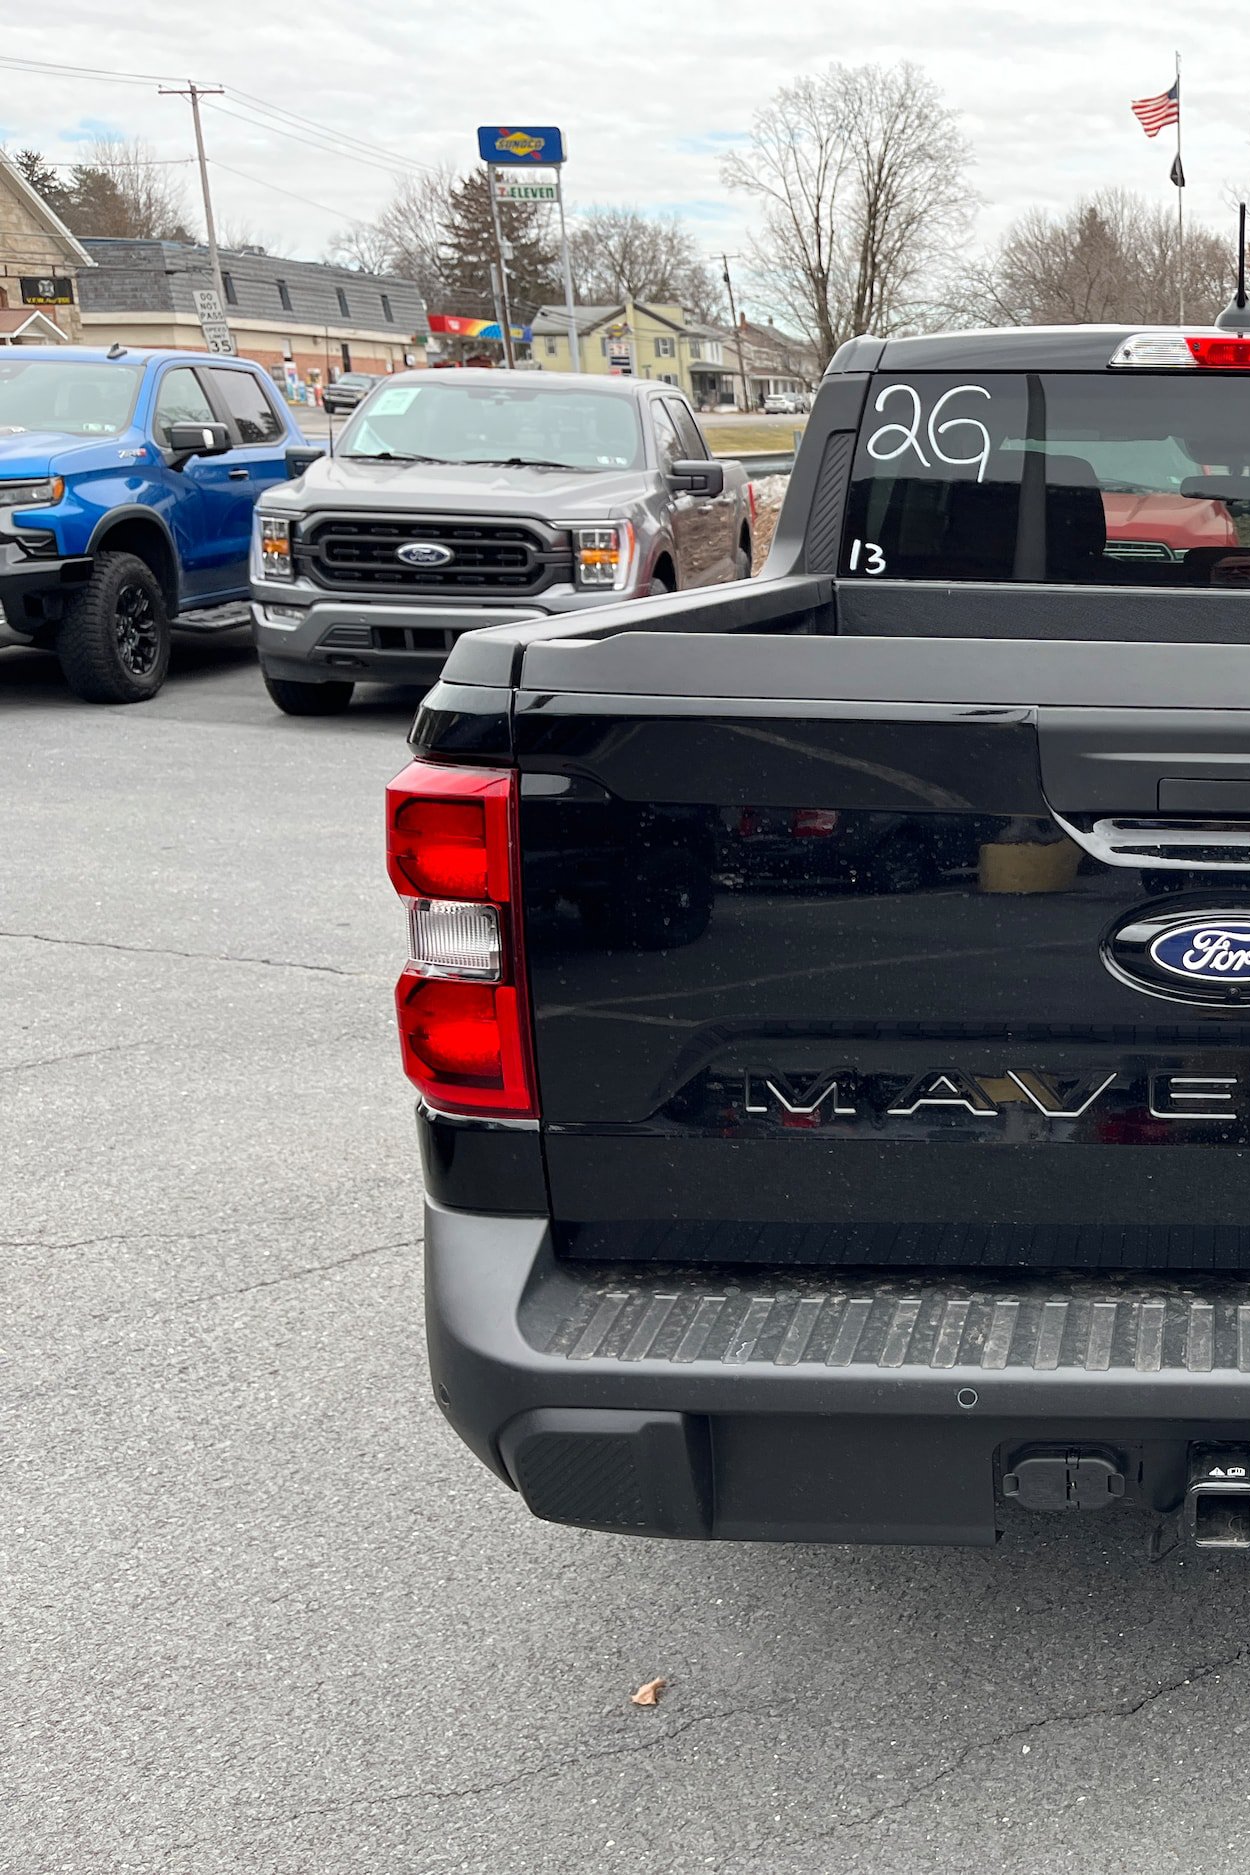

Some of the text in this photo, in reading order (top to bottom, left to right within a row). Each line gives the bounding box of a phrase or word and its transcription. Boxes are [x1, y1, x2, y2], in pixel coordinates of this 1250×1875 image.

[200, 293, 213, 301] DO
[201, 302, 217, 310] NOT
[201, 312, 223, 320] PASS
[210, 340, 231, 353] 35
[850, 539, 886, 574] 13
